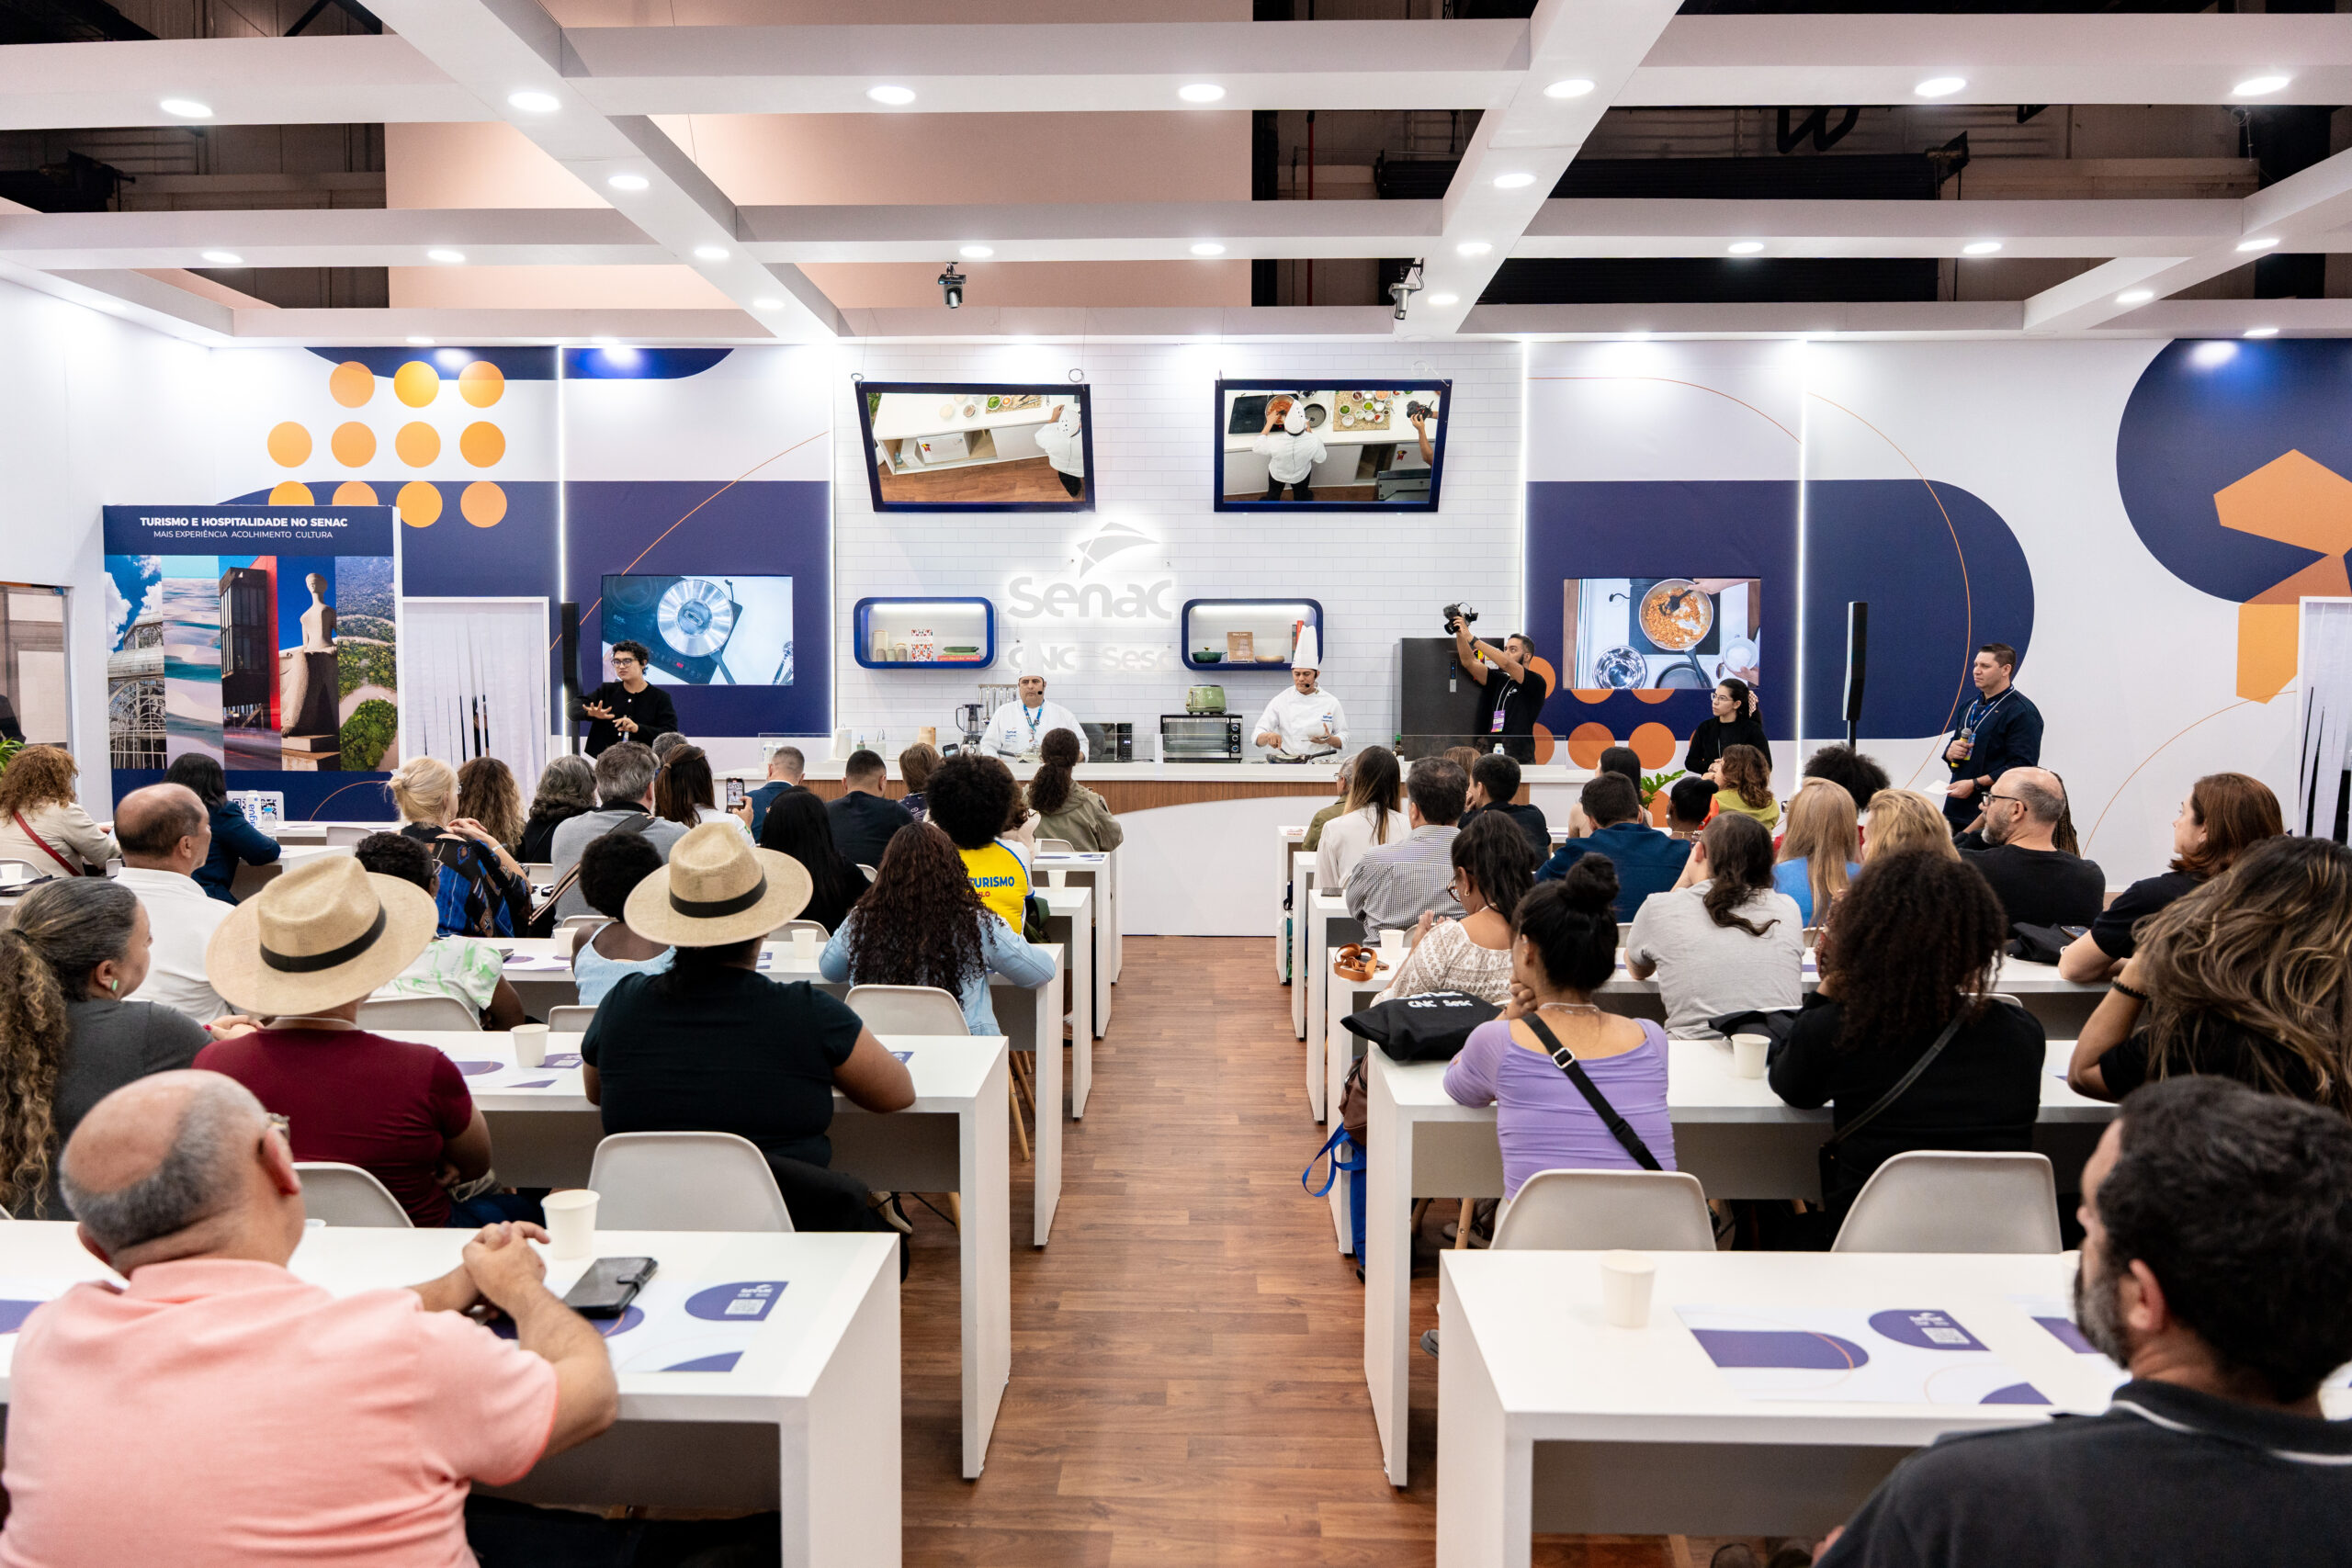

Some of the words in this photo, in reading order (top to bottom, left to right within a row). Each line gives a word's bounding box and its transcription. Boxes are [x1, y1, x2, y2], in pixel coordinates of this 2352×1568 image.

[140, 517, 189, 526] TURISMO
[191, 517, 199, 526] E
[201, 517, 288, 527] HOSPITALIDADE
[290, 517, 308, 527] NO
[310, 518, 348, 527] SENAC
[175, 529, 228, 538] EXPERIÊNCIA
[231, 530, 292, 538] ACOLHIMENTO
[1007, 576, 1173, 620] Senac
